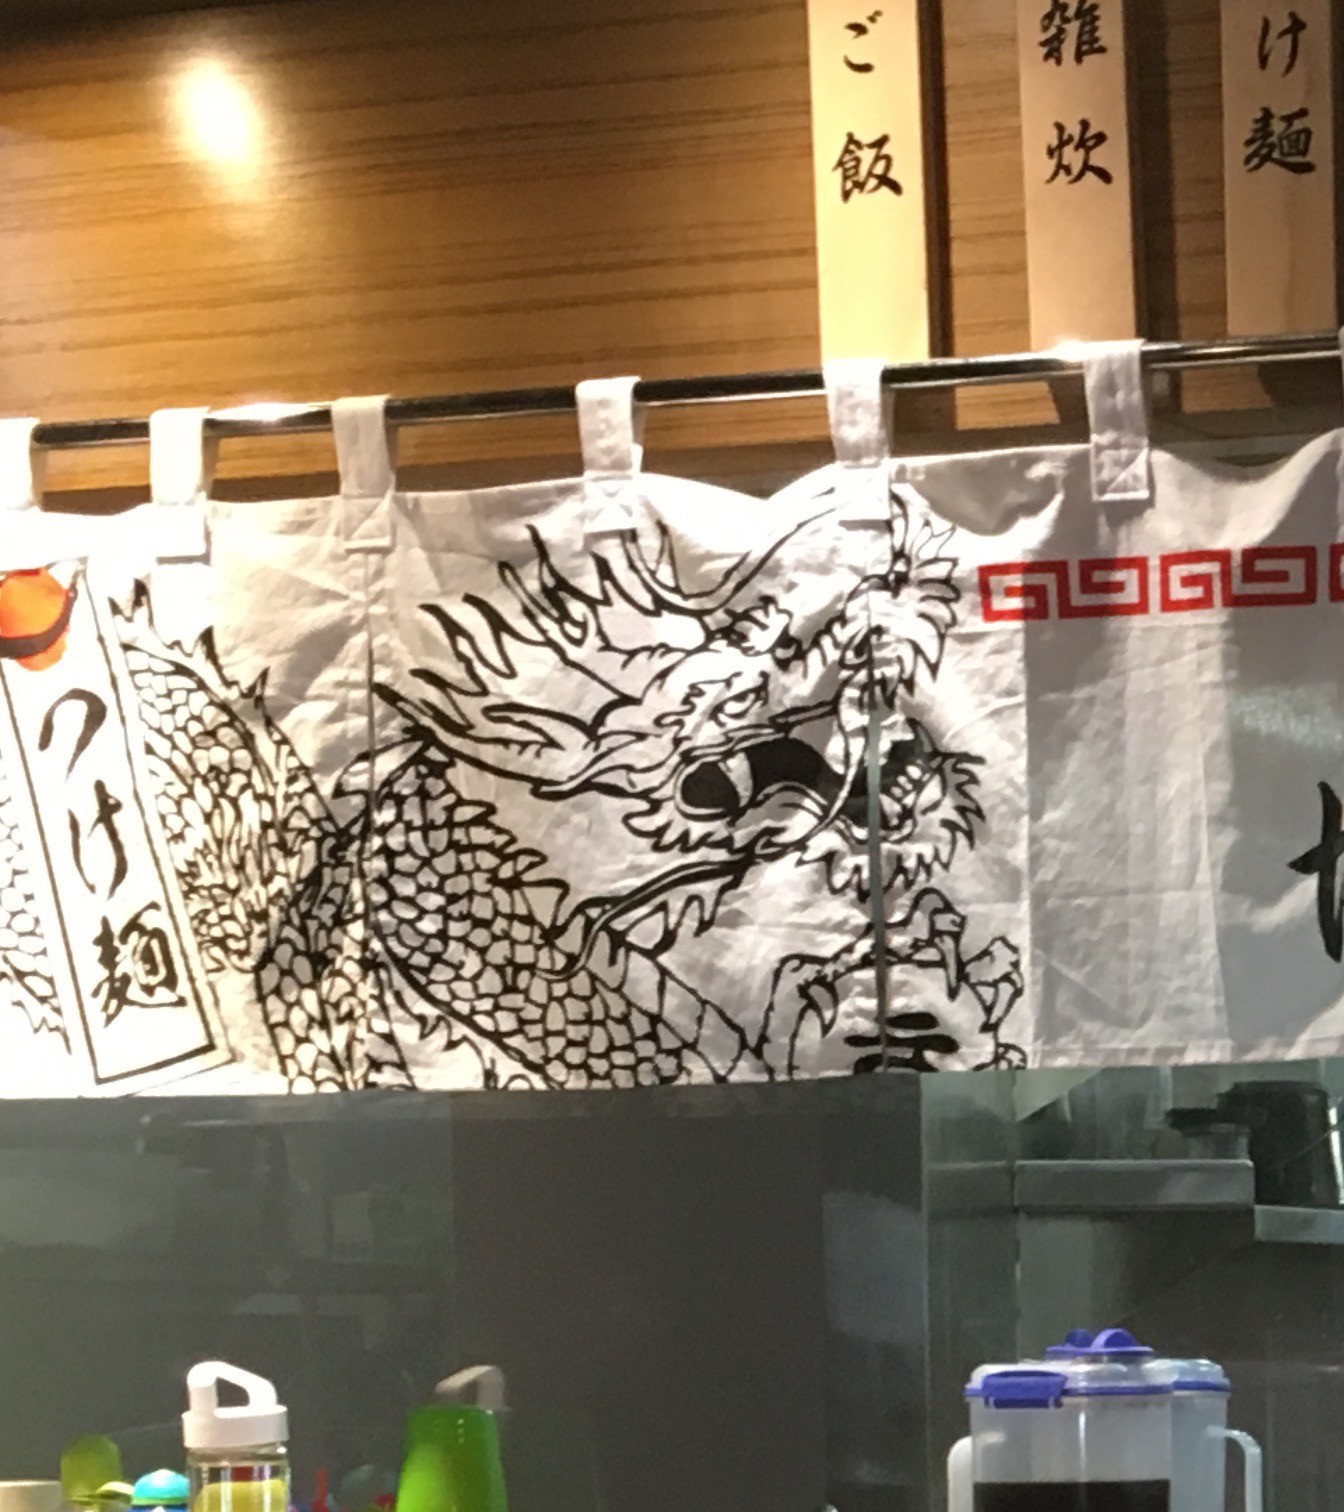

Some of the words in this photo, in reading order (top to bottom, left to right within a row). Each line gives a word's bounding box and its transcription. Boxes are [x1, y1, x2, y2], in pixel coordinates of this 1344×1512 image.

[832, 10, 903, 203] ご飯
[37, 687, 188, 1029] つけ麺
